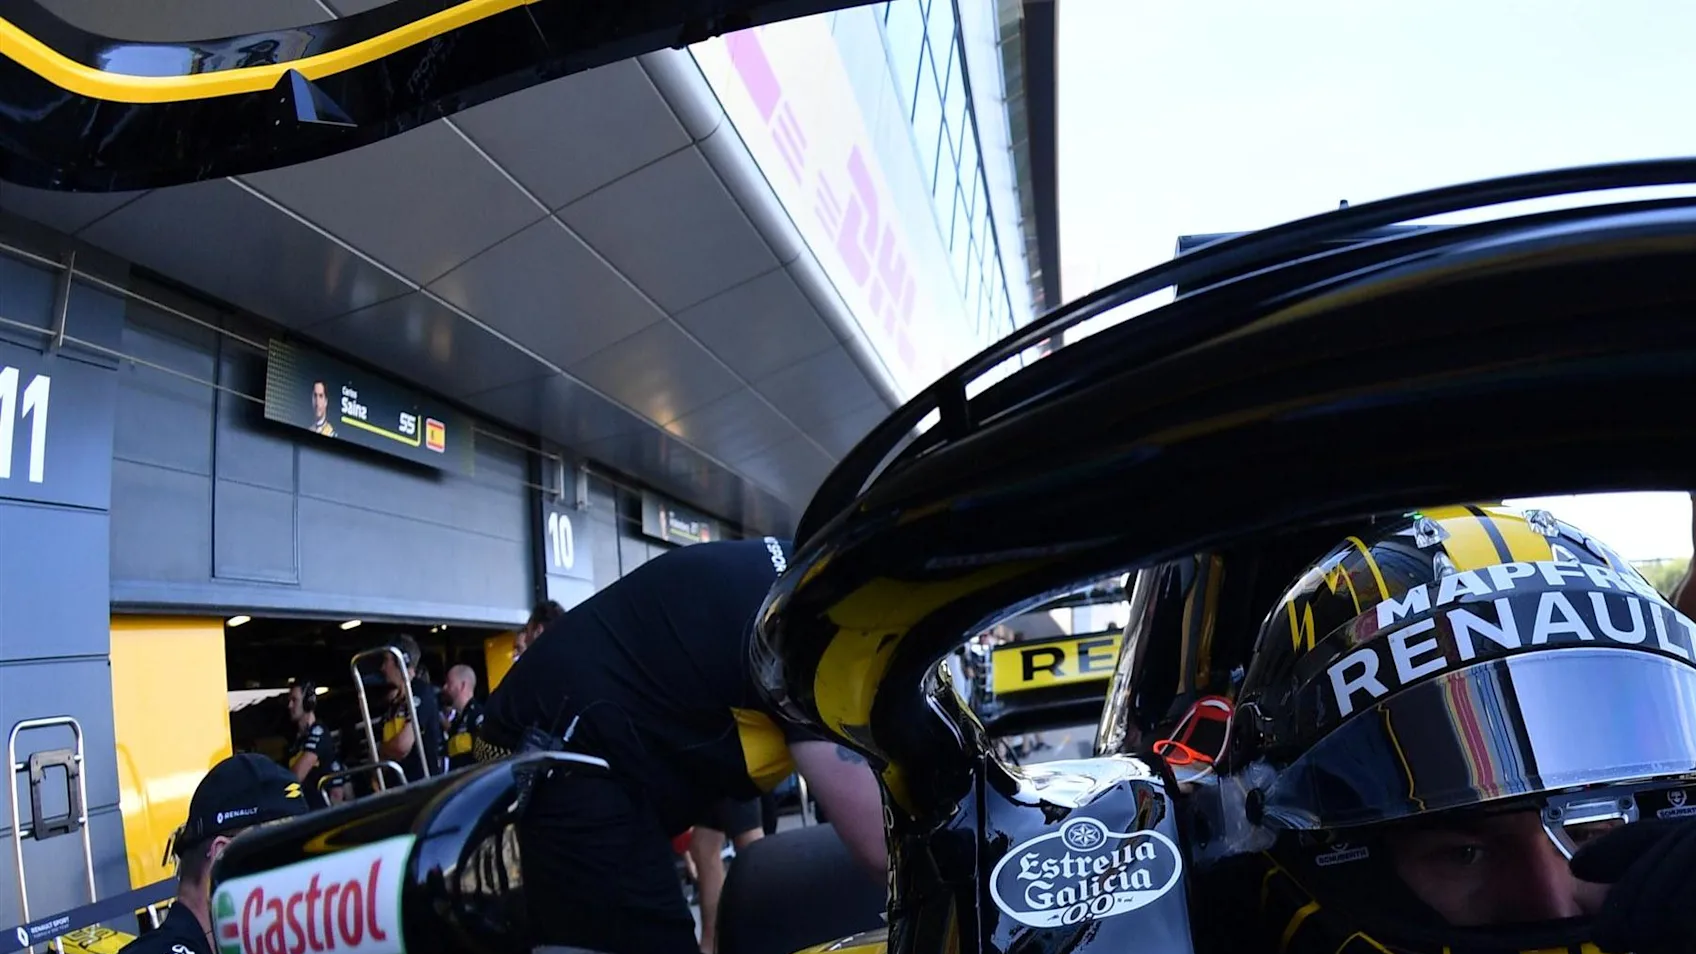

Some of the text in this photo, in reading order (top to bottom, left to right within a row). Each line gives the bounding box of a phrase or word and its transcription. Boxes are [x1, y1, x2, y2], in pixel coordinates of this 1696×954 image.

[0, 365, 51, 484] 11
[341, 397, 417, 435] Sainz 55
[548, 511, 574, 570] 10
[1017, 841, 1156, 880] Estrella
[1024, 864, 1153, 909] Galicia
